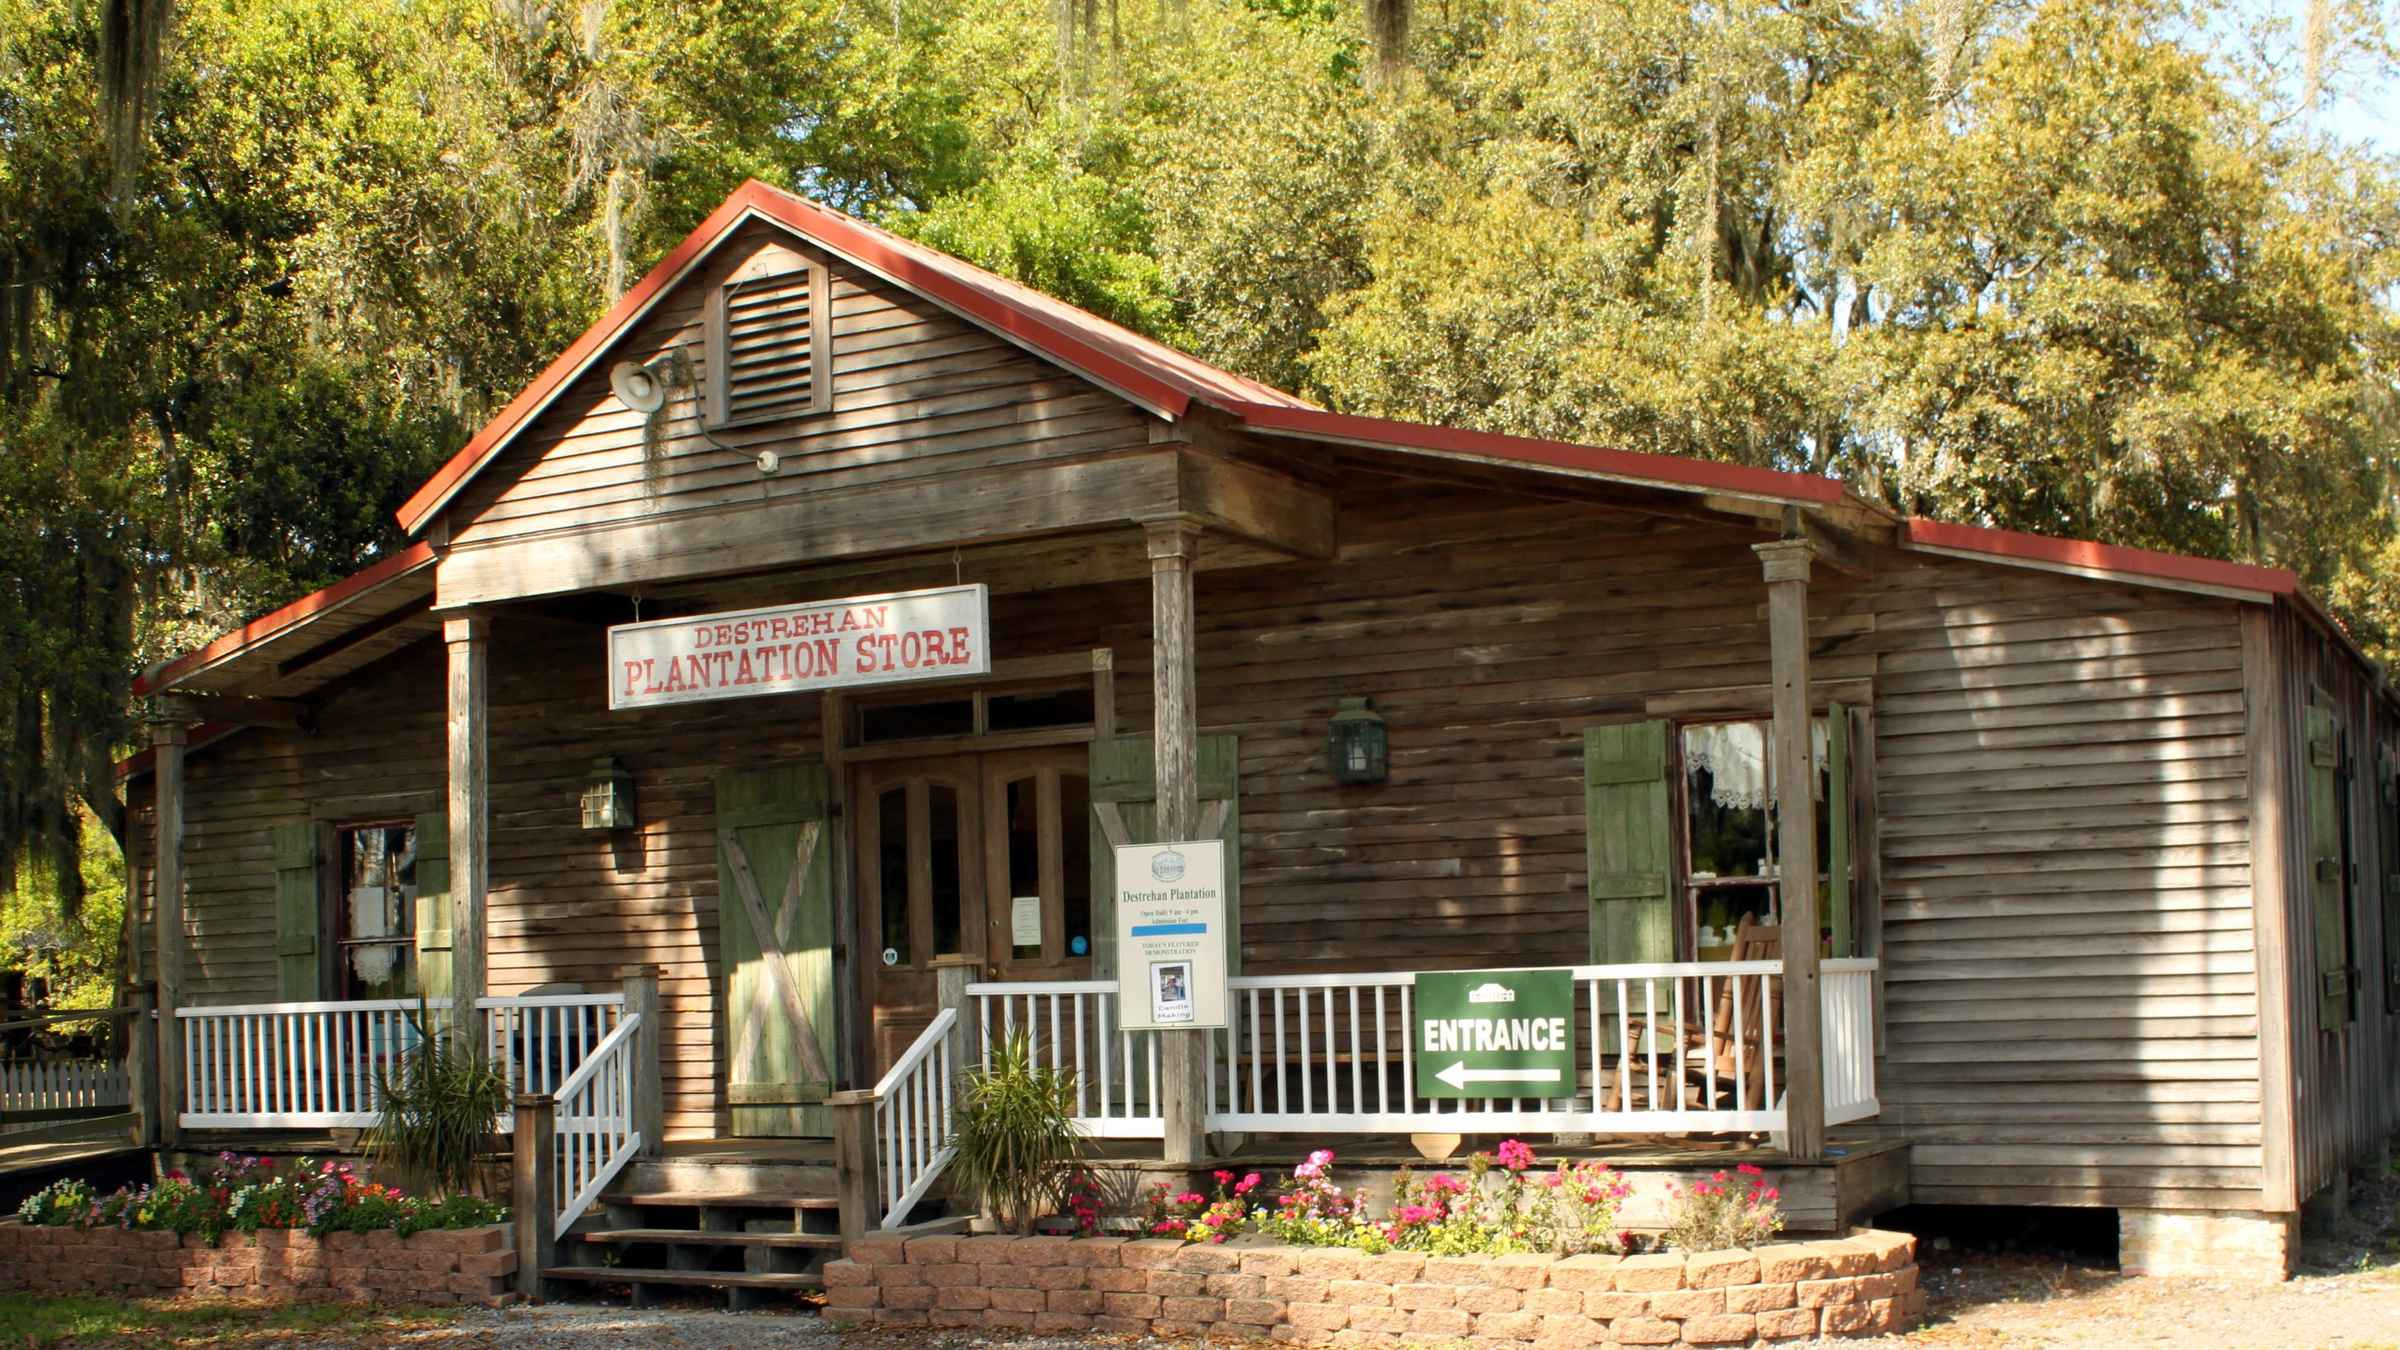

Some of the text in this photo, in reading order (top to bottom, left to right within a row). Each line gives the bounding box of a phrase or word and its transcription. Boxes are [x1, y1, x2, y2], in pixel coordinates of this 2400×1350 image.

[694, 606, 889, 649] DESTREHAN
[624, 627, 971, 696] PLANTATION STORE
[1123, 888, 1217, 903] Destrehan Plantation
[1424, 1018, 1566, 1051] ENTRANCE
